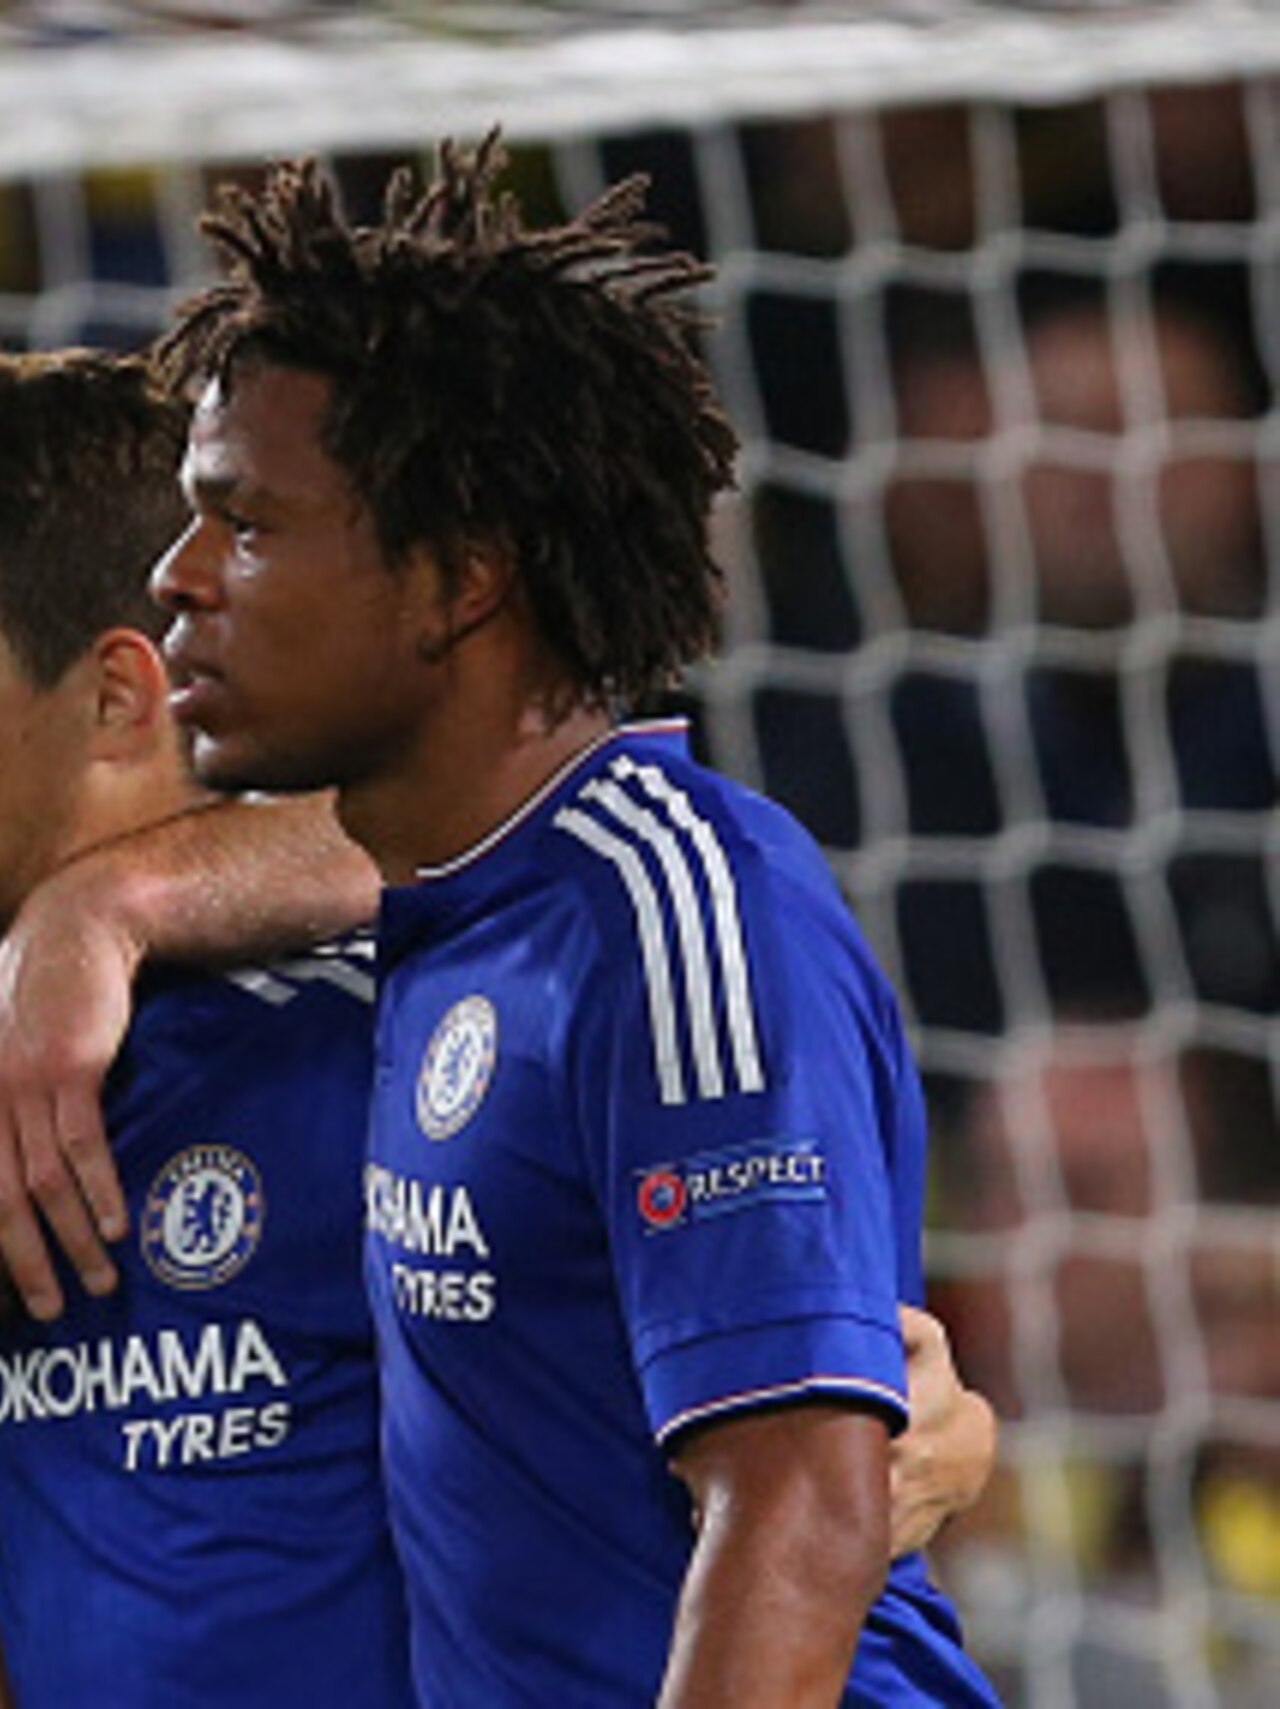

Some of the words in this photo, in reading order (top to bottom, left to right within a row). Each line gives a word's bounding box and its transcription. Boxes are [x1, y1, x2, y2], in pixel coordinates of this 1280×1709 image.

[686, 1154, 825, 1201] RESPECT
[391, 1262, 496, 1322] TYRES
[122, 1402, 292, 1472] TYRES
